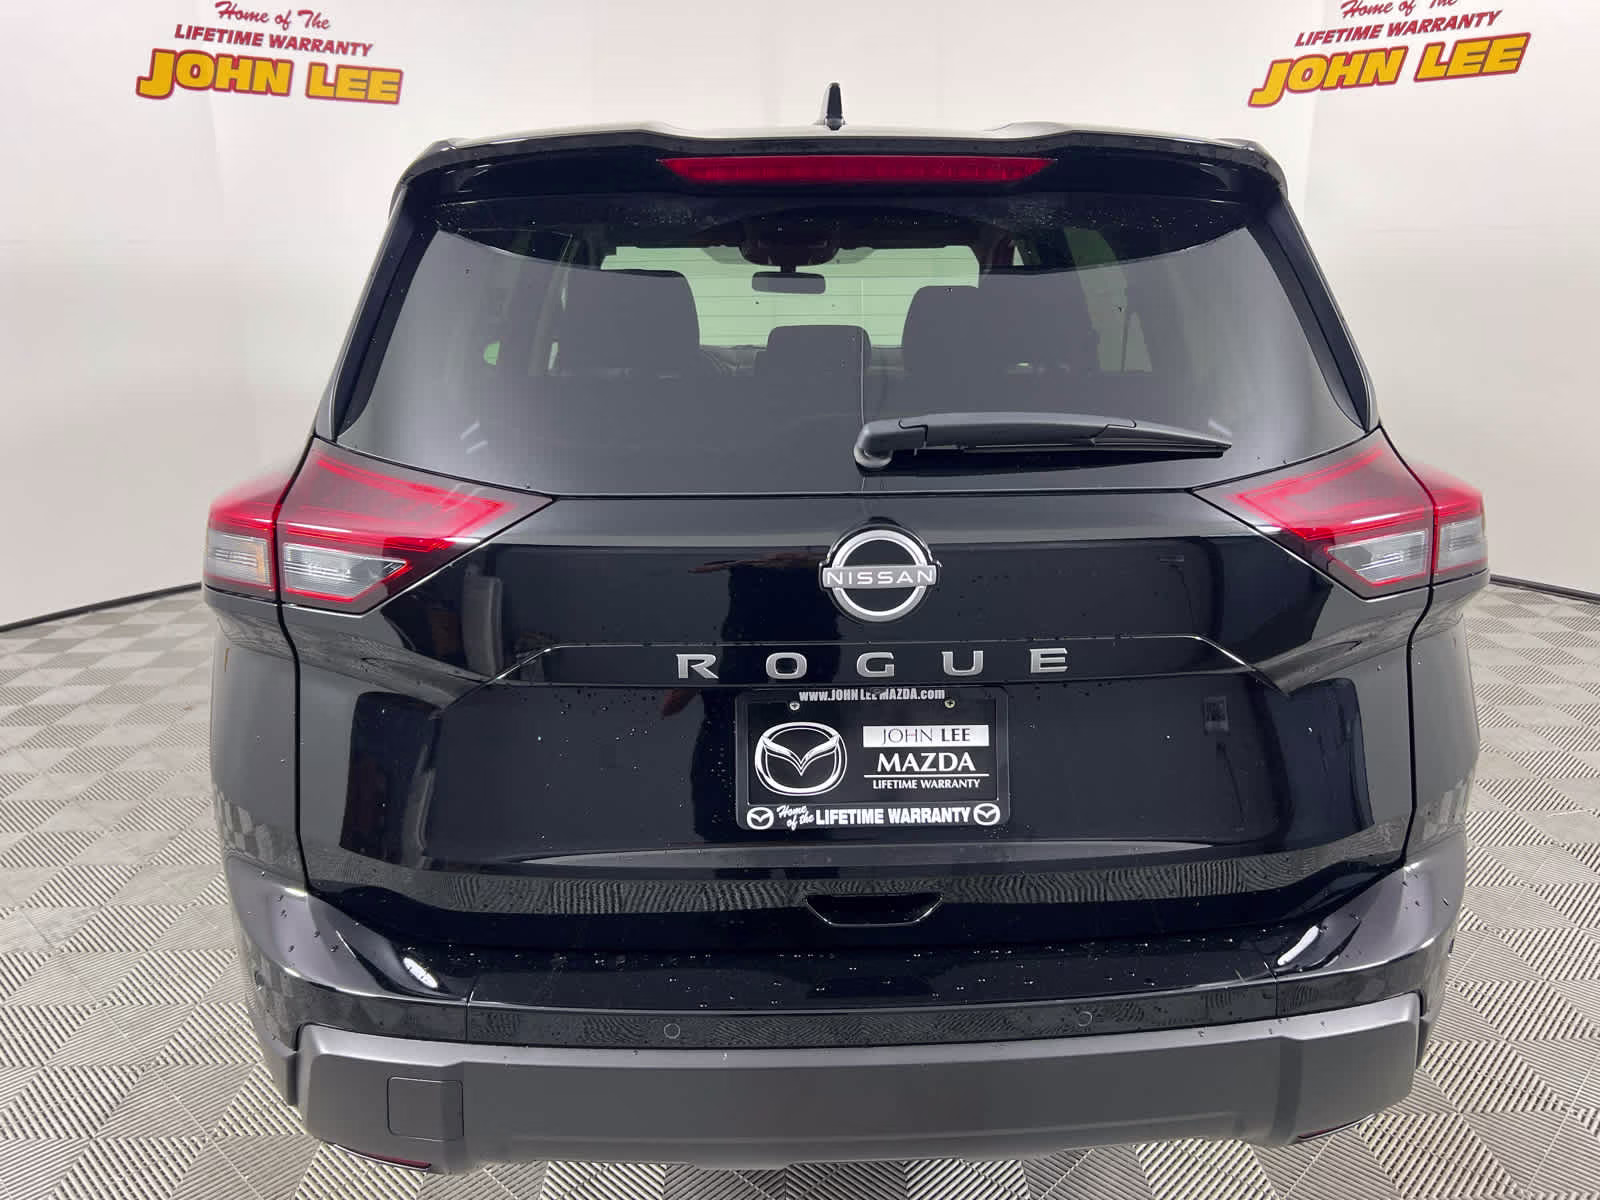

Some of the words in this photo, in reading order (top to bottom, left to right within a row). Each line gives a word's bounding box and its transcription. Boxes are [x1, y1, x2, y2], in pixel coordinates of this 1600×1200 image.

[215, 1, 269, 24] Home
[274, 9, 292, 31] of
[297, 10, 330, 29] The
[1340, 0, 1393, 18] Home
[1398, 0, 1416, 17] of
[1294, 24, 1384, 47] LIFETIME
[1386, 10, 1502, 38] WARRANTY
[174, 24, 264, 47] LIFETIME
[269, 33, 373, 57] WARRANTY
[136, 48, 294, 100] JOHN
[305, 62, 404, 104] LEE
[1248, 46, 1409, 108] JOHN
[1413, 32, 1531, 82] LEE
[826, 569, 934, 586] NISSAN
[676, 647, 1068, 679] ROGUE
[881, 727, 934, 744] JOHN
[941, 728, 971, 742] LEE
[877, 752, 976, 772] MAZDA
[872, 779, 919, 789] LIFETIME
[921, 778, 981, 789] WARRANTY
[776, 805, 807, 818] Home
[786, 815, 798, 831] of
[799, 811, 815, 825] the
[815, 808, 884, 825] LIFETIME
[887, 806, 971, 824] WARRANTY
